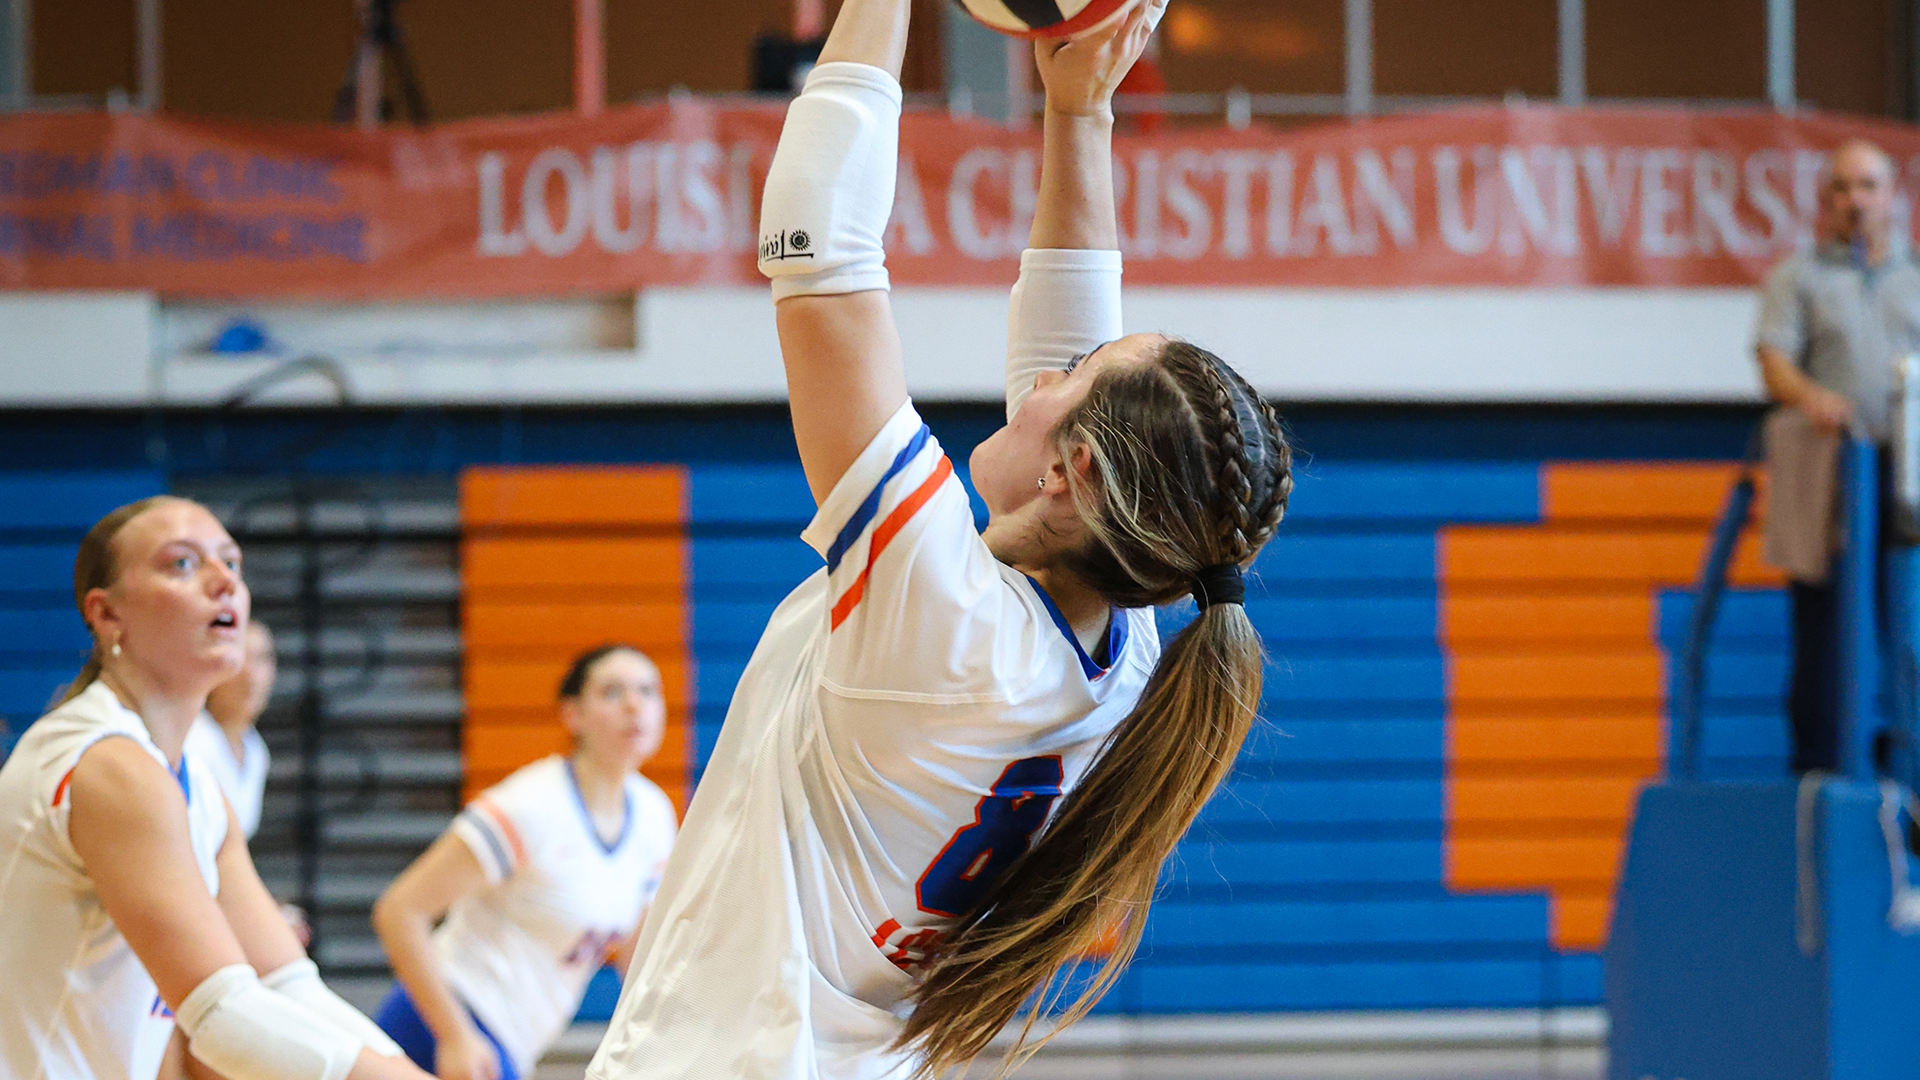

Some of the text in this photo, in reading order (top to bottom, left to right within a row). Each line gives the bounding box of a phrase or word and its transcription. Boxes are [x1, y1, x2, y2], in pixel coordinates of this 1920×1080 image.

[476, 139, 1920, 262] LOUISIA CHISTIAN UNIVERSI
[915, 755, 1063, 918] 8
